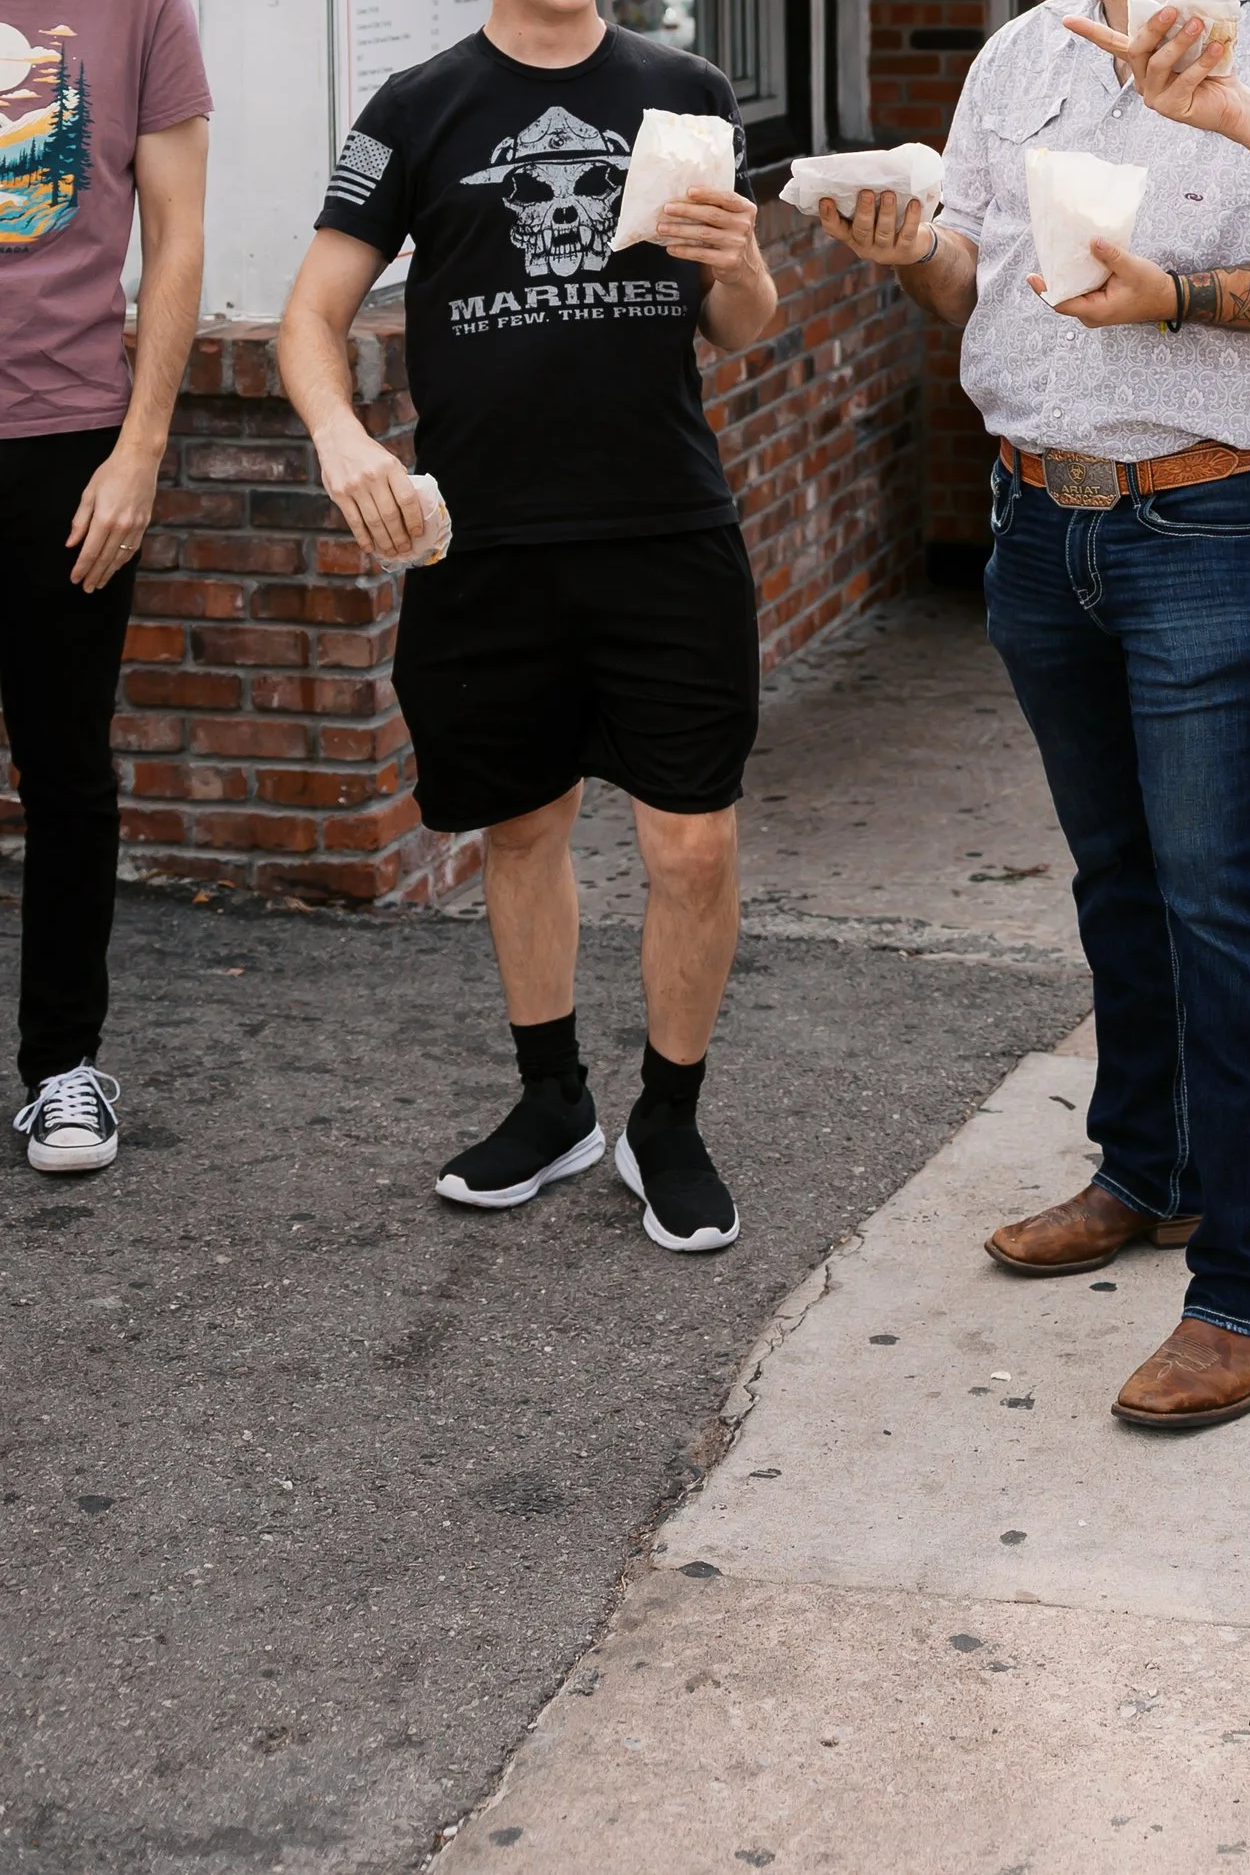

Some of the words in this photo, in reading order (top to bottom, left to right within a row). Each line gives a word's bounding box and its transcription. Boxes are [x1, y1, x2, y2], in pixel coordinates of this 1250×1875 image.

[448, 280, 680, 321] MARINES
[452, 320, 489, 336] THE
[497, 312, 550, 328] FEW.
[558, 308, 605, 320] THE
[1061, 484, 1101, 495] ARIAT
